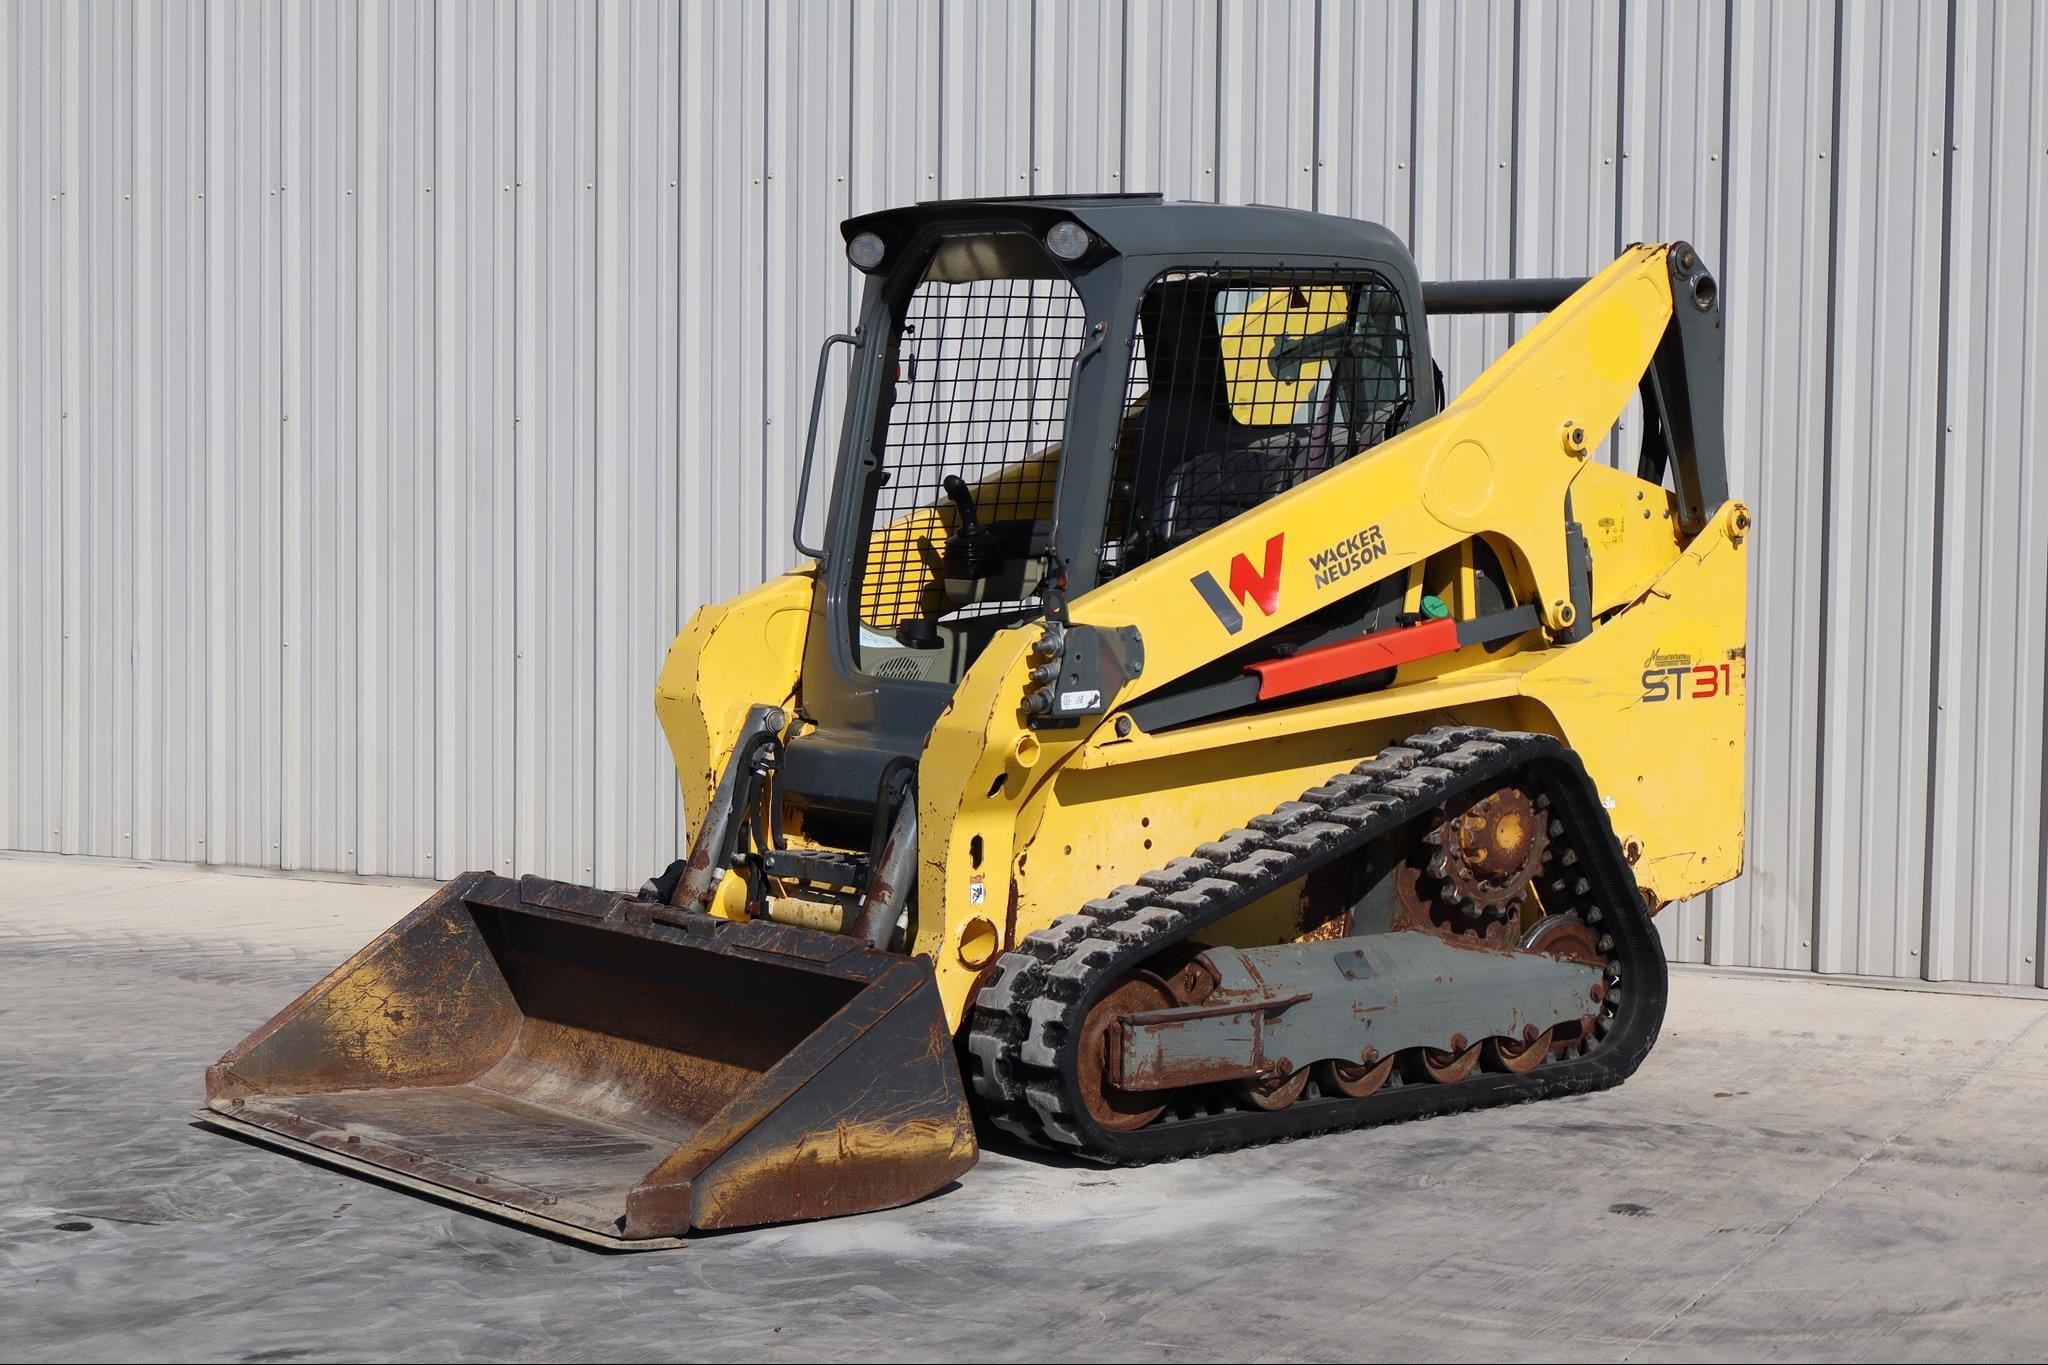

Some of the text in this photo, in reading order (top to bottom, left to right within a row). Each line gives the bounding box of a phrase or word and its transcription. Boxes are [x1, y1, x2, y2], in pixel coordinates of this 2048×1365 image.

[1308, 524, 1383, 571] WACKER
[1314, 539, 1387, 590] NEUSON
[1641, 664, 1730, 703] ST31
